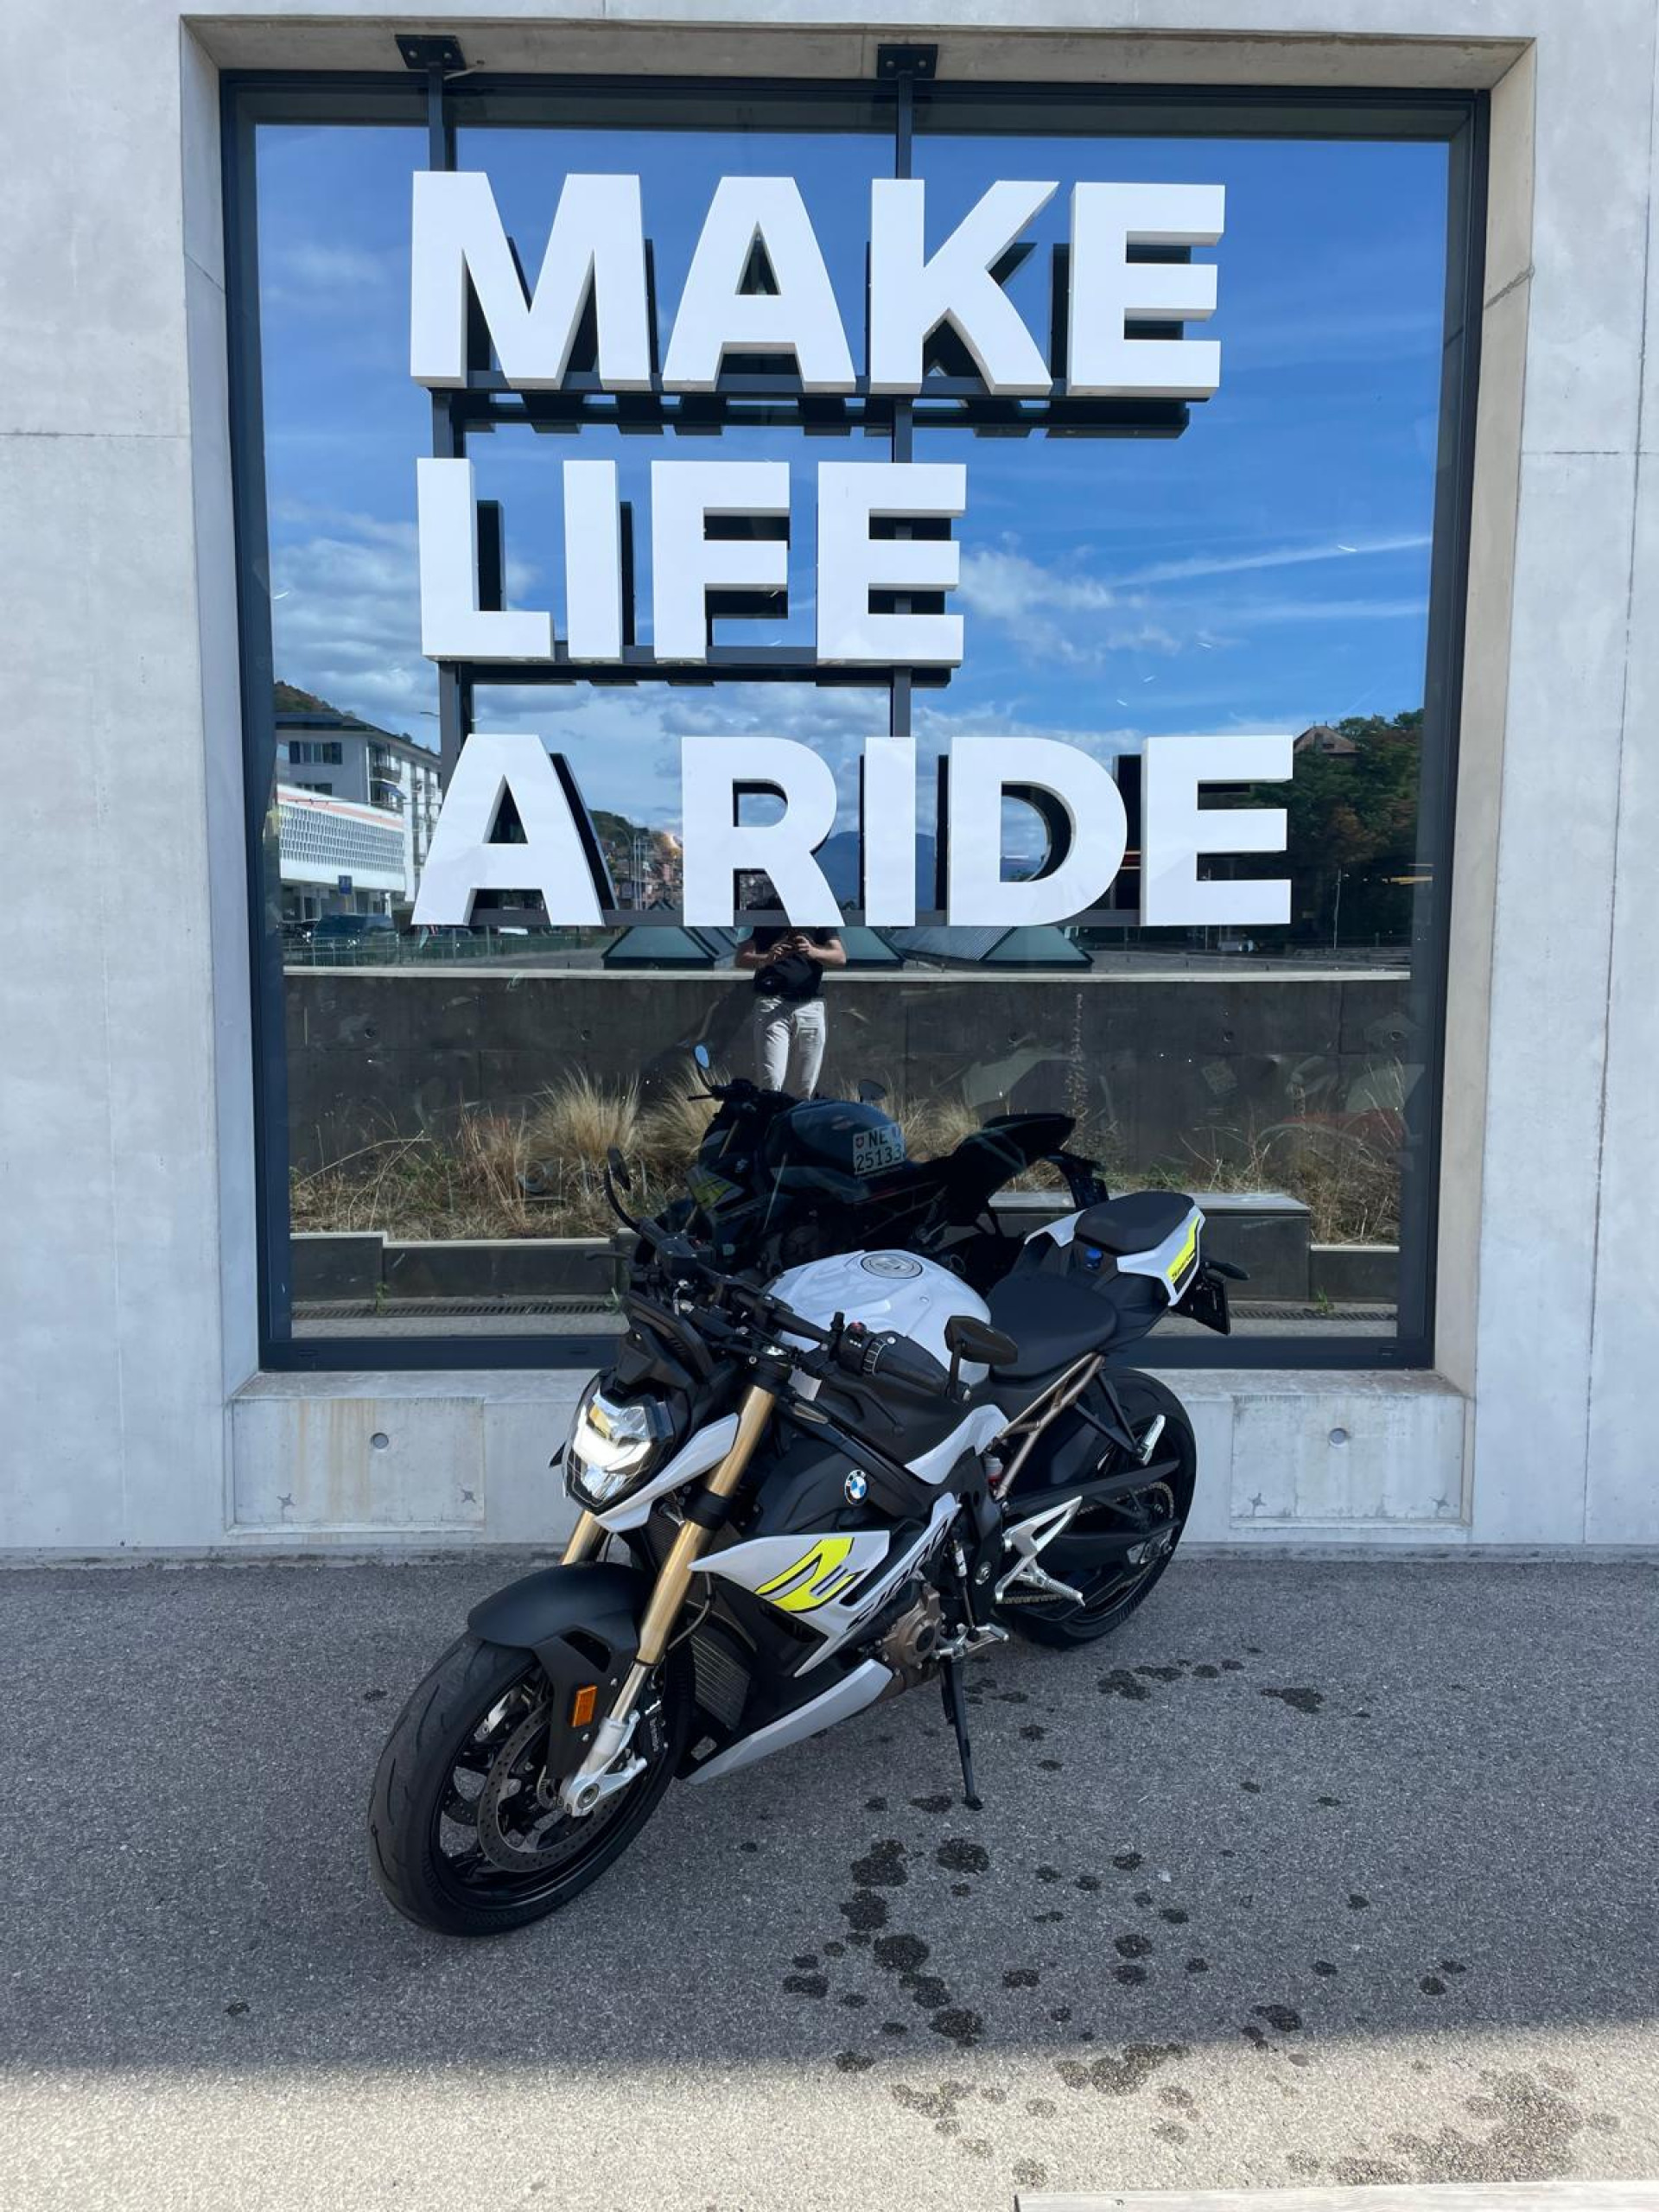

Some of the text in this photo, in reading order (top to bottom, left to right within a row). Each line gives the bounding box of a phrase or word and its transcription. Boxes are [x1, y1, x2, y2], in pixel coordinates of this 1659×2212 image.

[410, 171, 1226, 397] MAKE
[416, 459, 967, 664] LIFE
[411, 734, 1293, 927] A RIDE
[856, 1143, 902, 1171] 25133
[868, 1130, 888, 1147] NE
